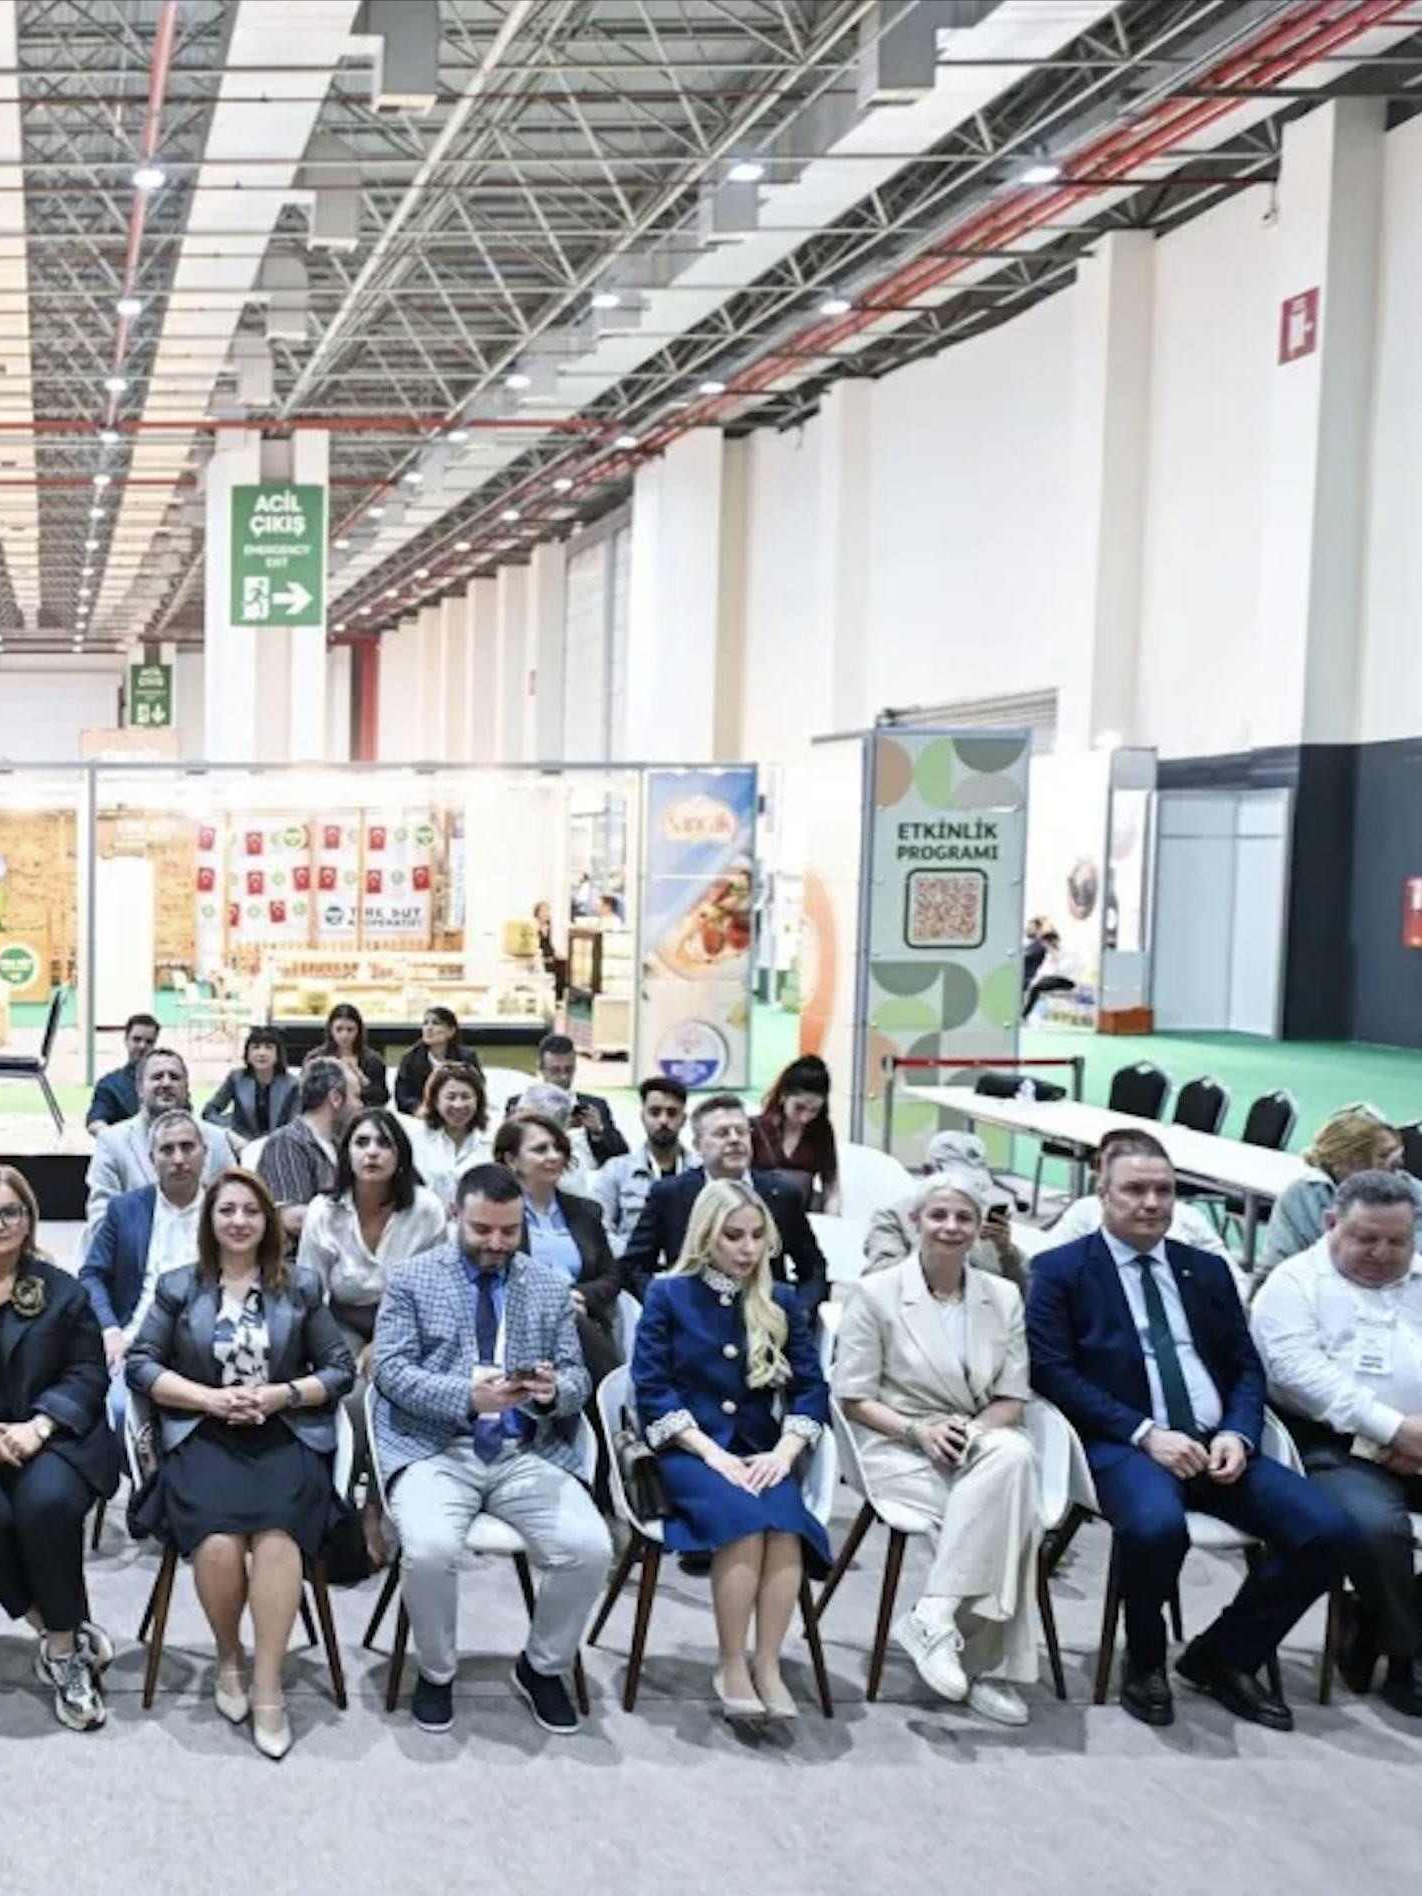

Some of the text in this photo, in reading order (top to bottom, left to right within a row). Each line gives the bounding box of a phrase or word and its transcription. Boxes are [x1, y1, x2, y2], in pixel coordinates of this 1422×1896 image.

[254, 489, 302, 512] ACİL
[249, 515, 307, 538] ÇIKIŞ
[897, 816, 998, 840] ETKİNLİK
[896, 845, 999, 861] PROGRAMI
